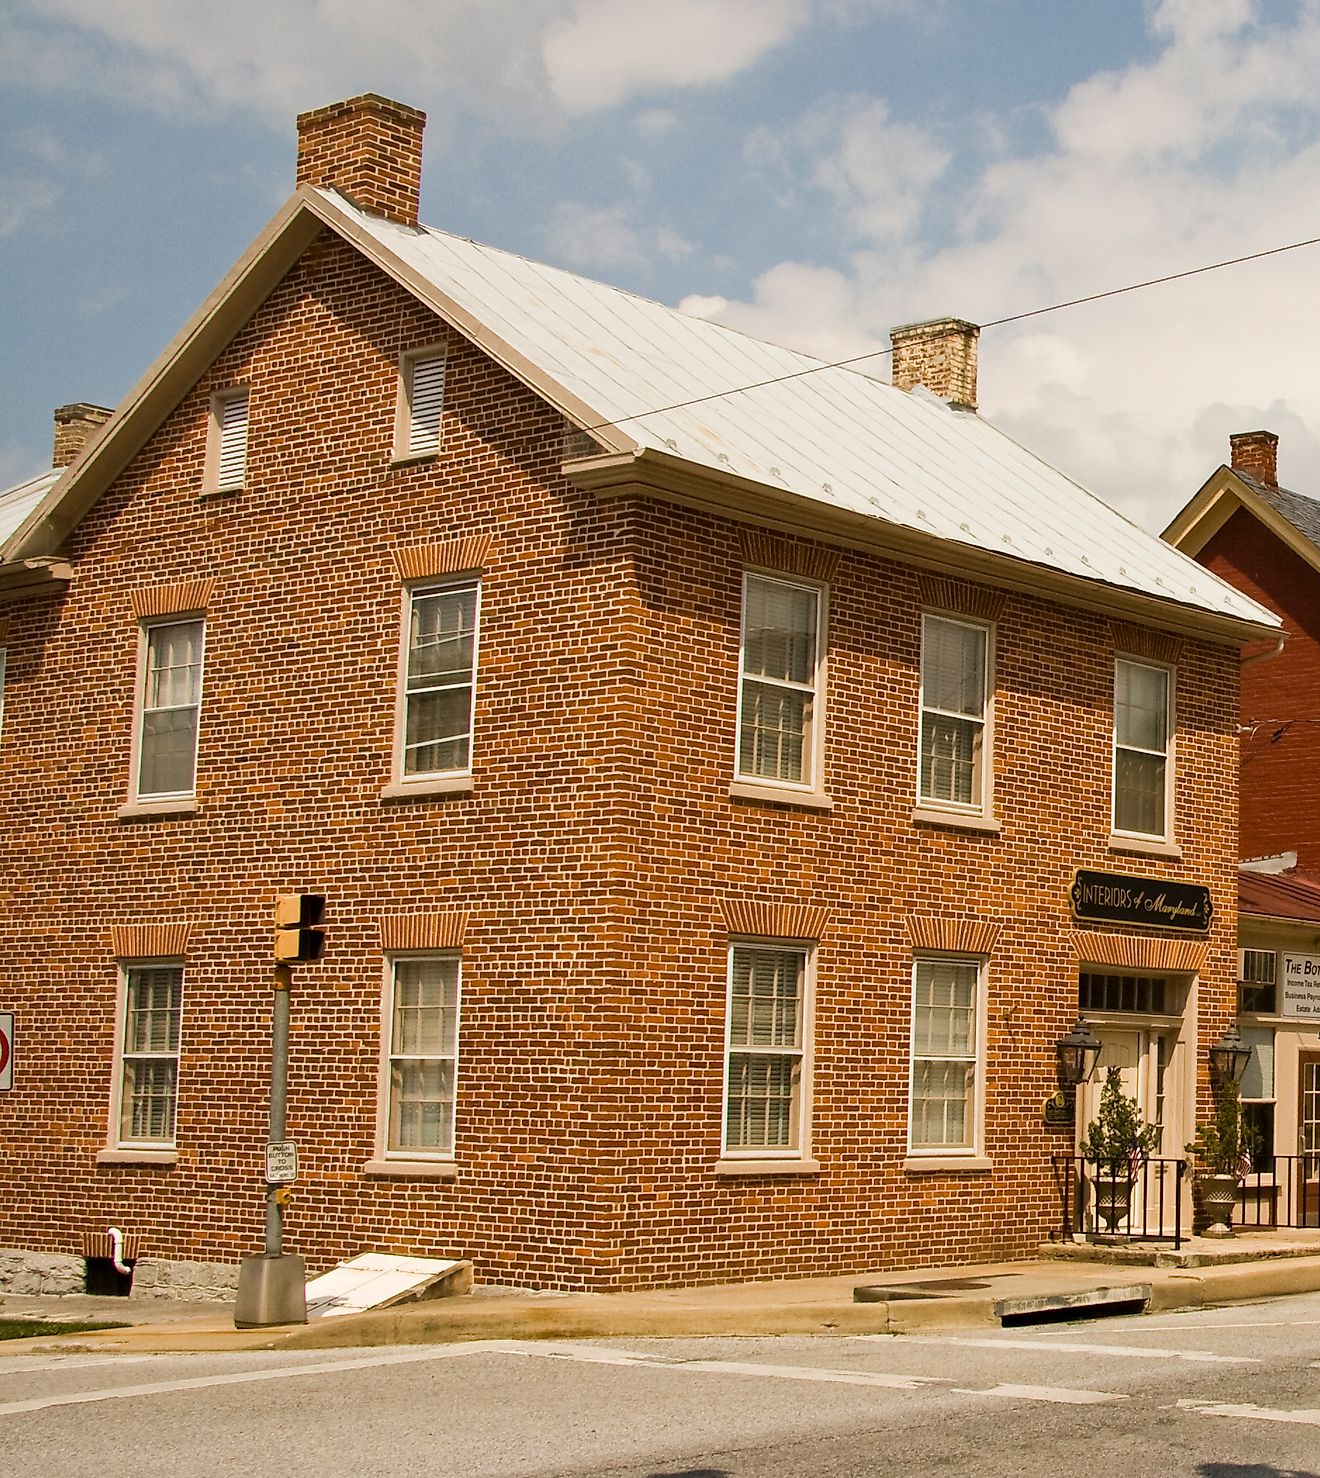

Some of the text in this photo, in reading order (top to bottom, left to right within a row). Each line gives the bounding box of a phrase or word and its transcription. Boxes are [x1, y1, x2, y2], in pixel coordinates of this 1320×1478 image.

[1083, 884, 1198, 921] INTERIORS of Maryland
[1285, 959, 1302, 975] THE
[1287, 979, 1304, 987] Income
[1304, 980, 1312, 988] Tax
[1285, 991, 1306, 1000] Business
[1296, 1005, 1311, 1013] Estate
